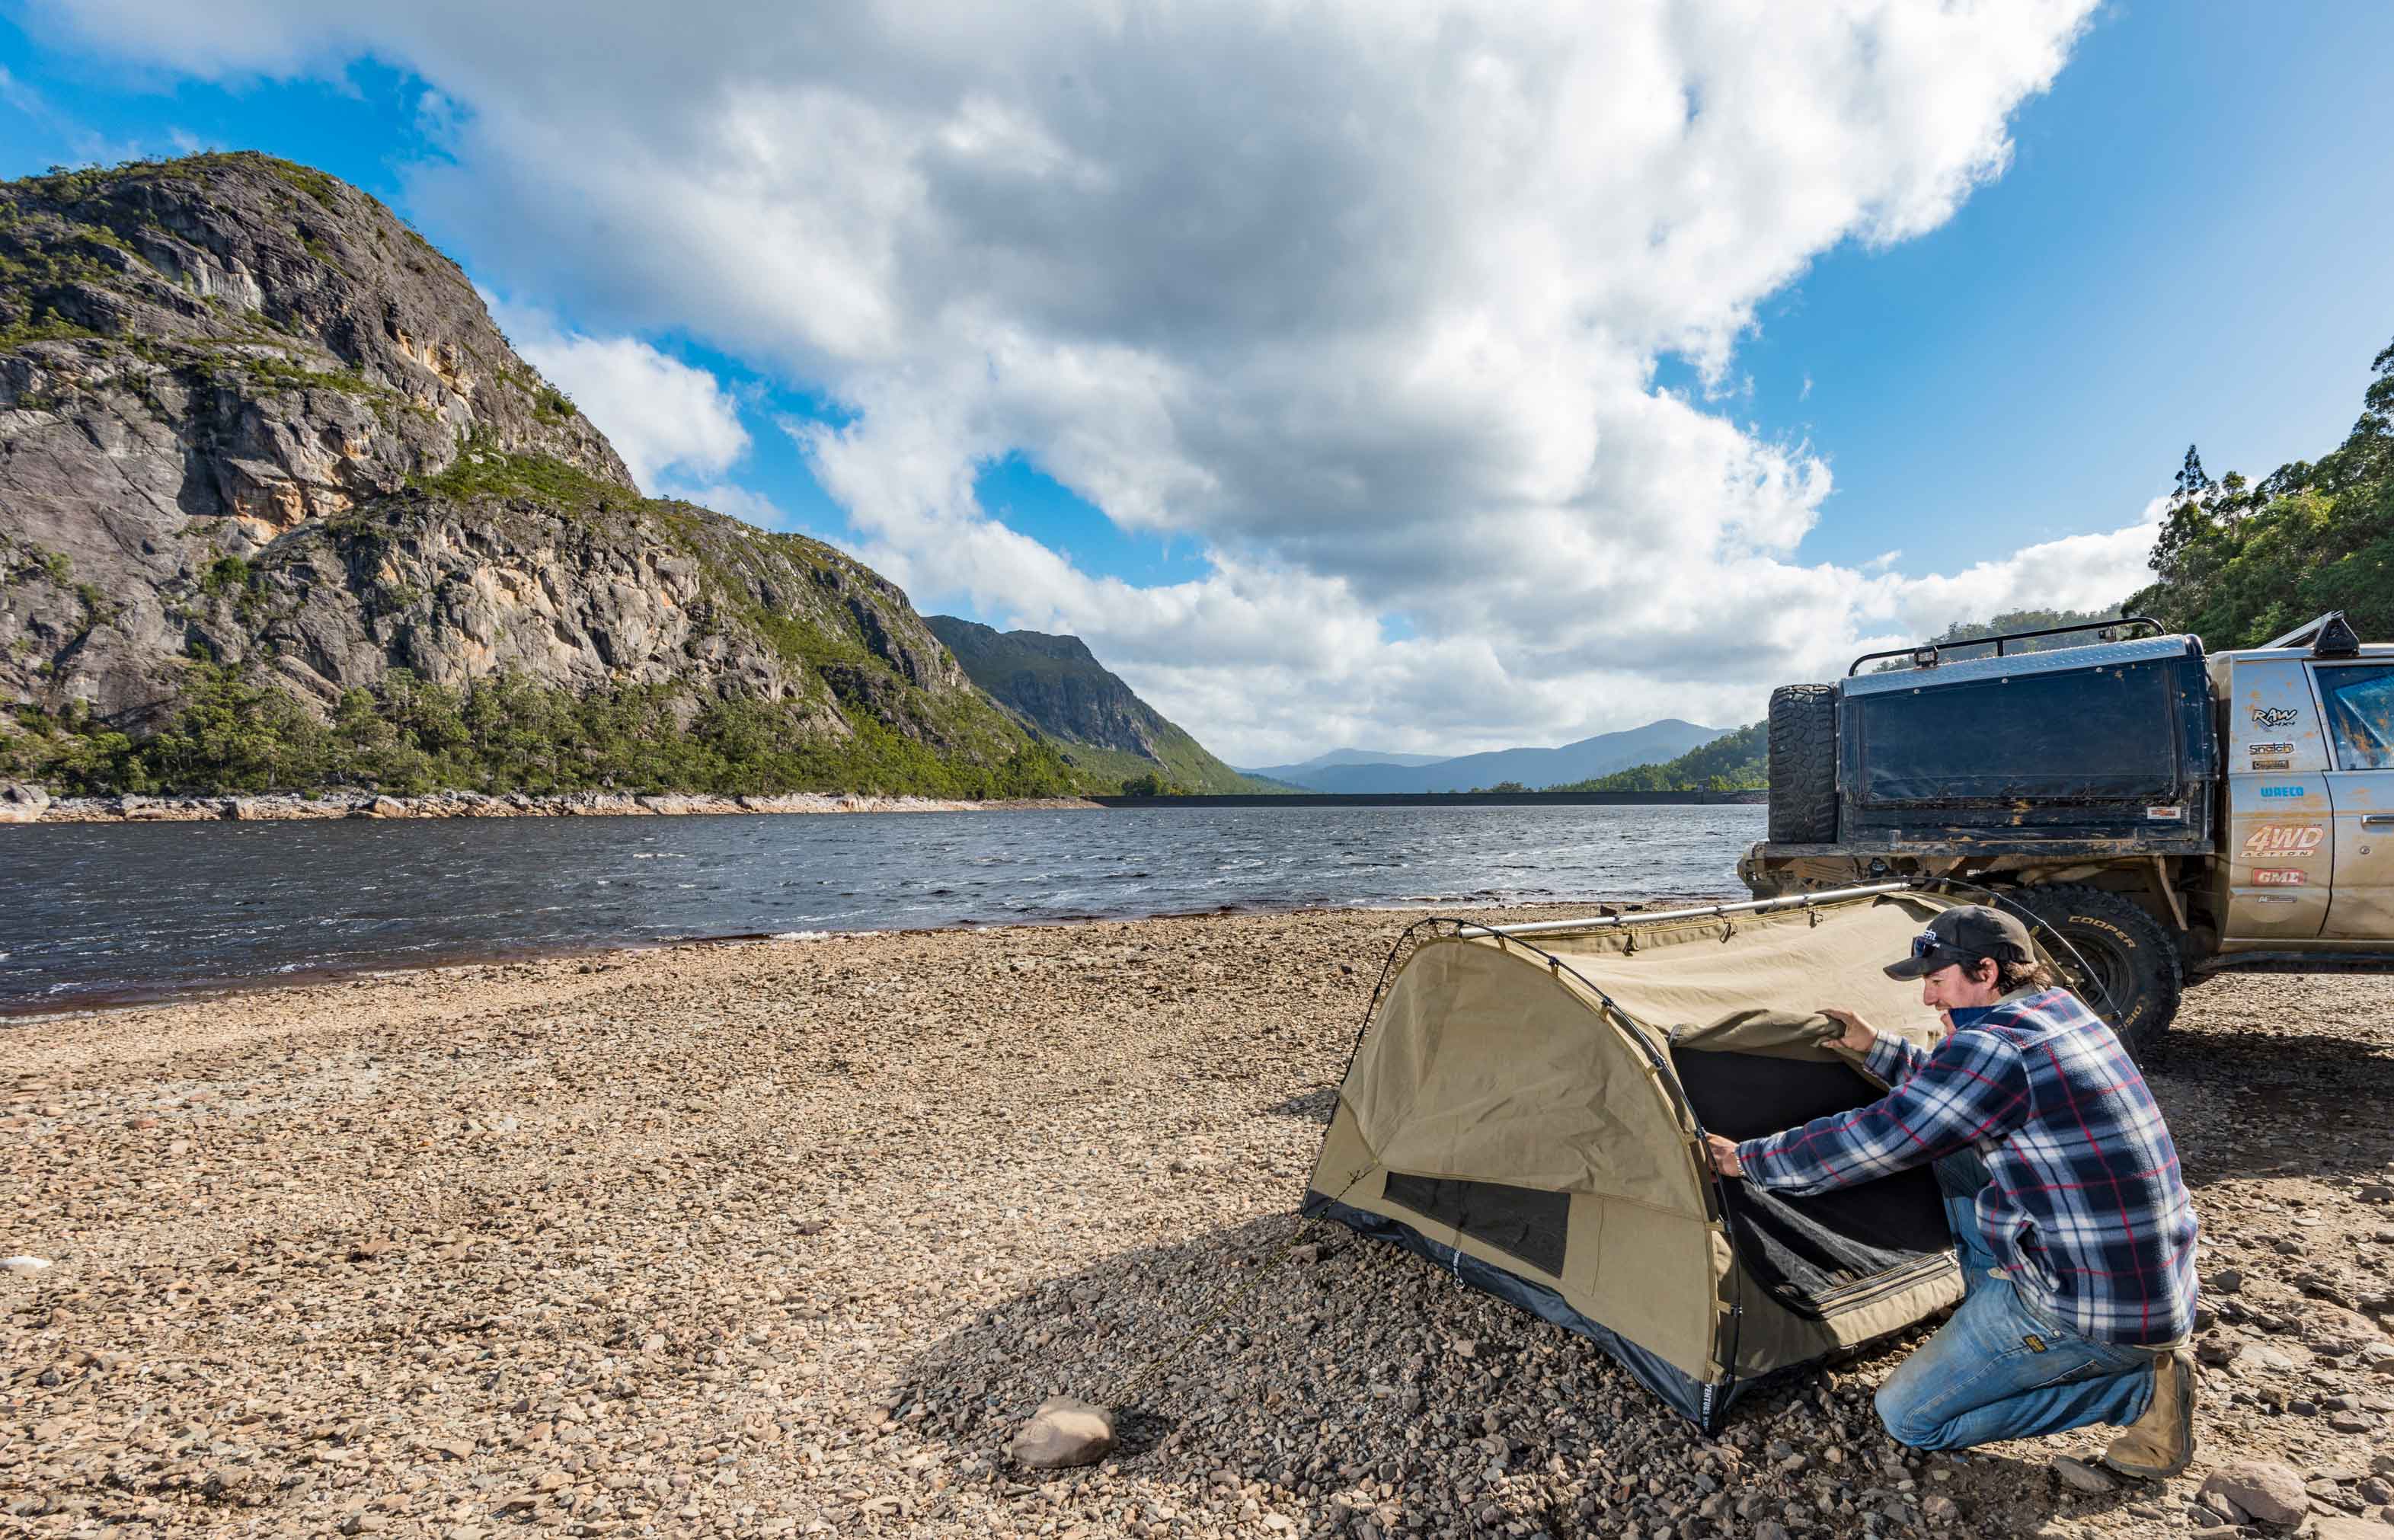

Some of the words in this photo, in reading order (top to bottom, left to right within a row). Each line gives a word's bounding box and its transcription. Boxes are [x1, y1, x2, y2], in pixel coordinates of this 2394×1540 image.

[2252, 708, 2298, 727] RAW
[2245, 825, 2325, 851] 4WD
[2257, 871, 2300, 884] GME
[2068, 915, 2137, 948] COOPER
